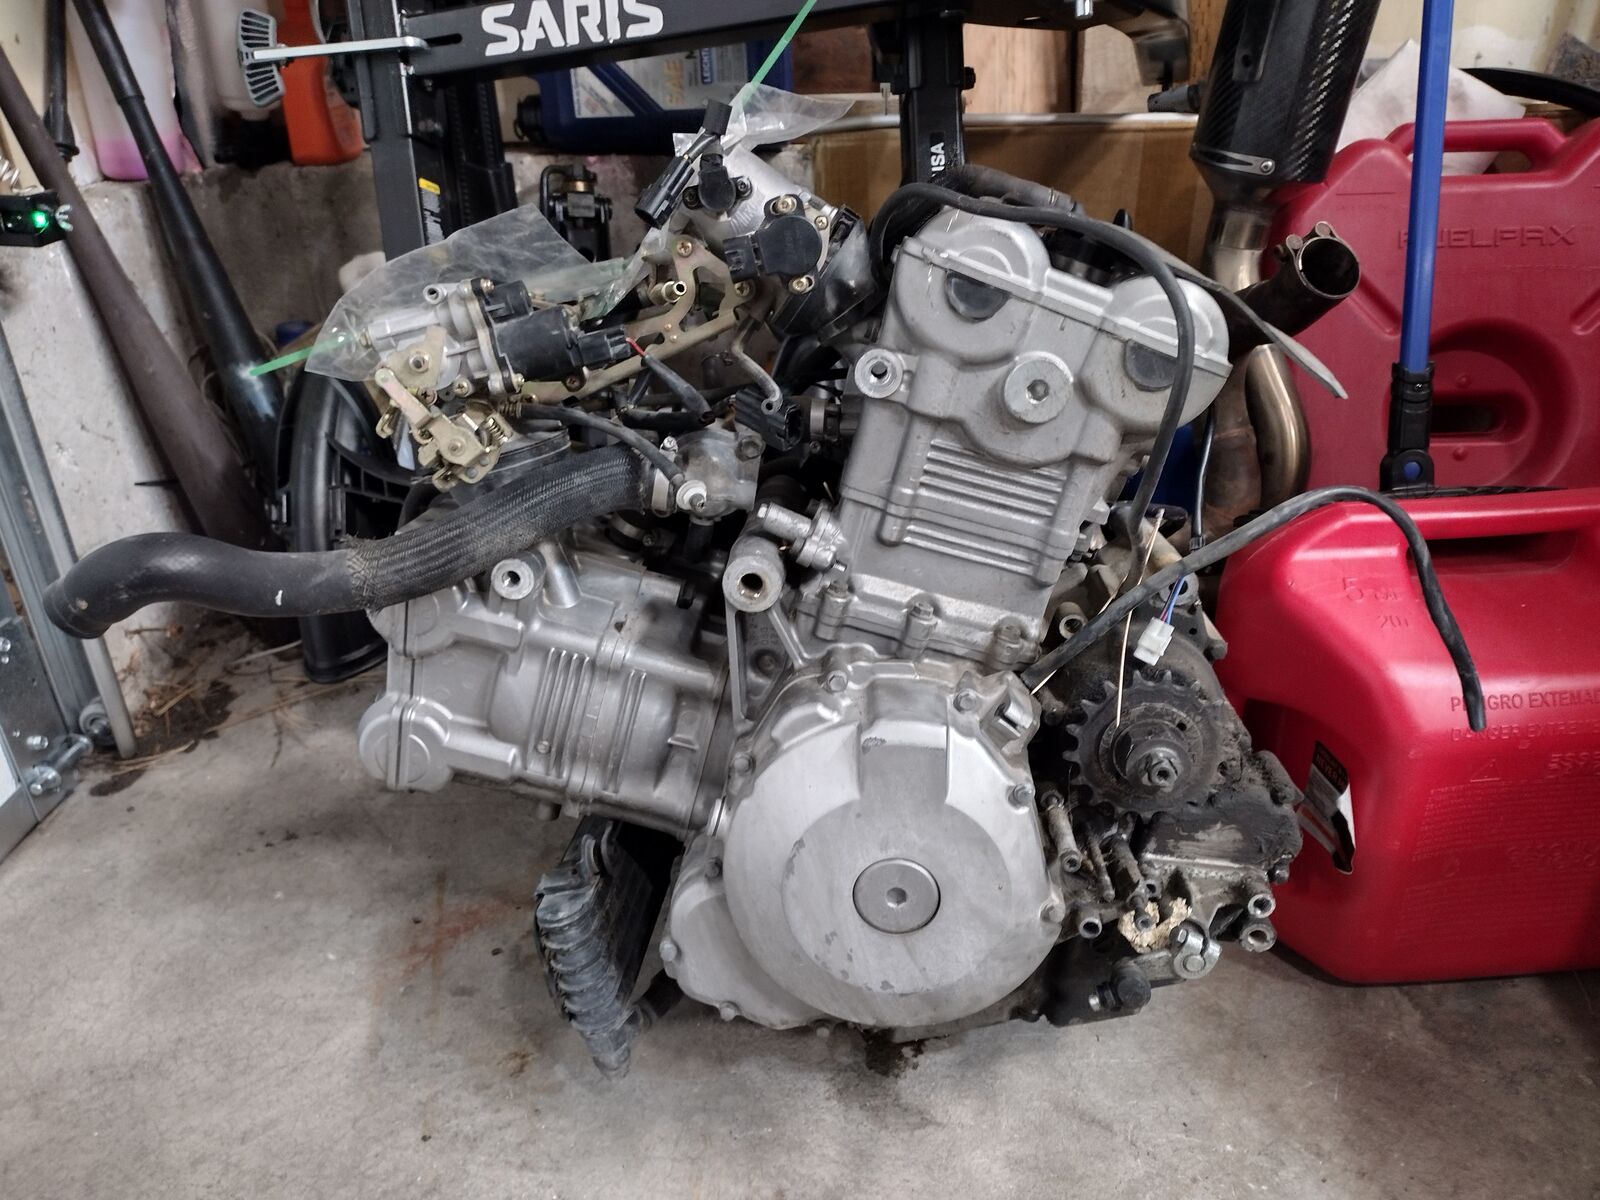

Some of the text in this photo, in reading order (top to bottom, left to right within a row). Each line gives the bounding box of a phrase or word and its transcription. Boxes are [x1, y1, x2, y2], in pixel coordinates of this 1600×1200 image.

[481, 0, 664, 57] SARIS
[663, 60, 684, 105] SAE
[1341, 577, 1364, 604] 5
[1450, 693, 1524, 712] PIGRO
